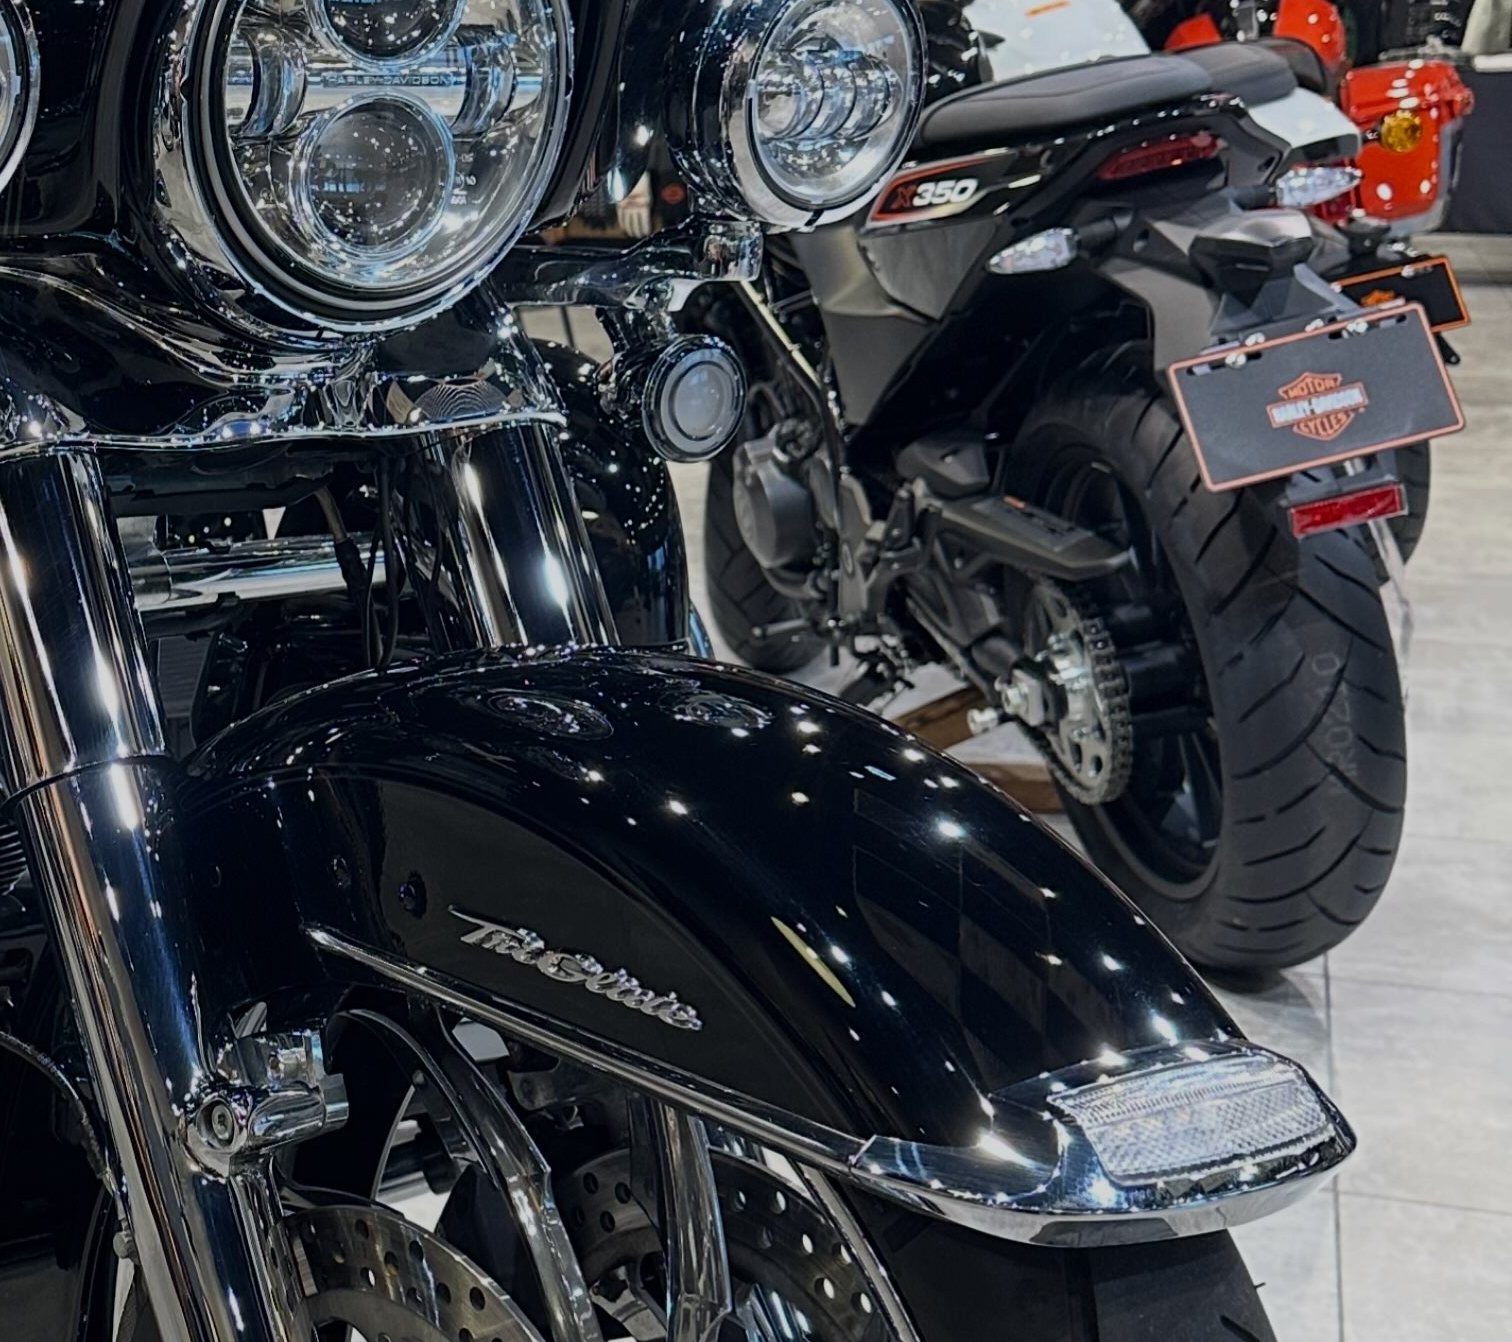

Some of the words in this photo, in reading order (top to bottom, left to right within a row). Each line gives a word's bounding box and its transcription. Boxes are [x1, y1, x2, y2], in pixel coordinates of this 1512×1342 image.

[891, 178, 978, 210] X350
[1289, 377, 1336, 398] MOTOR
[1299, 411, 1347, 435] CYCLES
